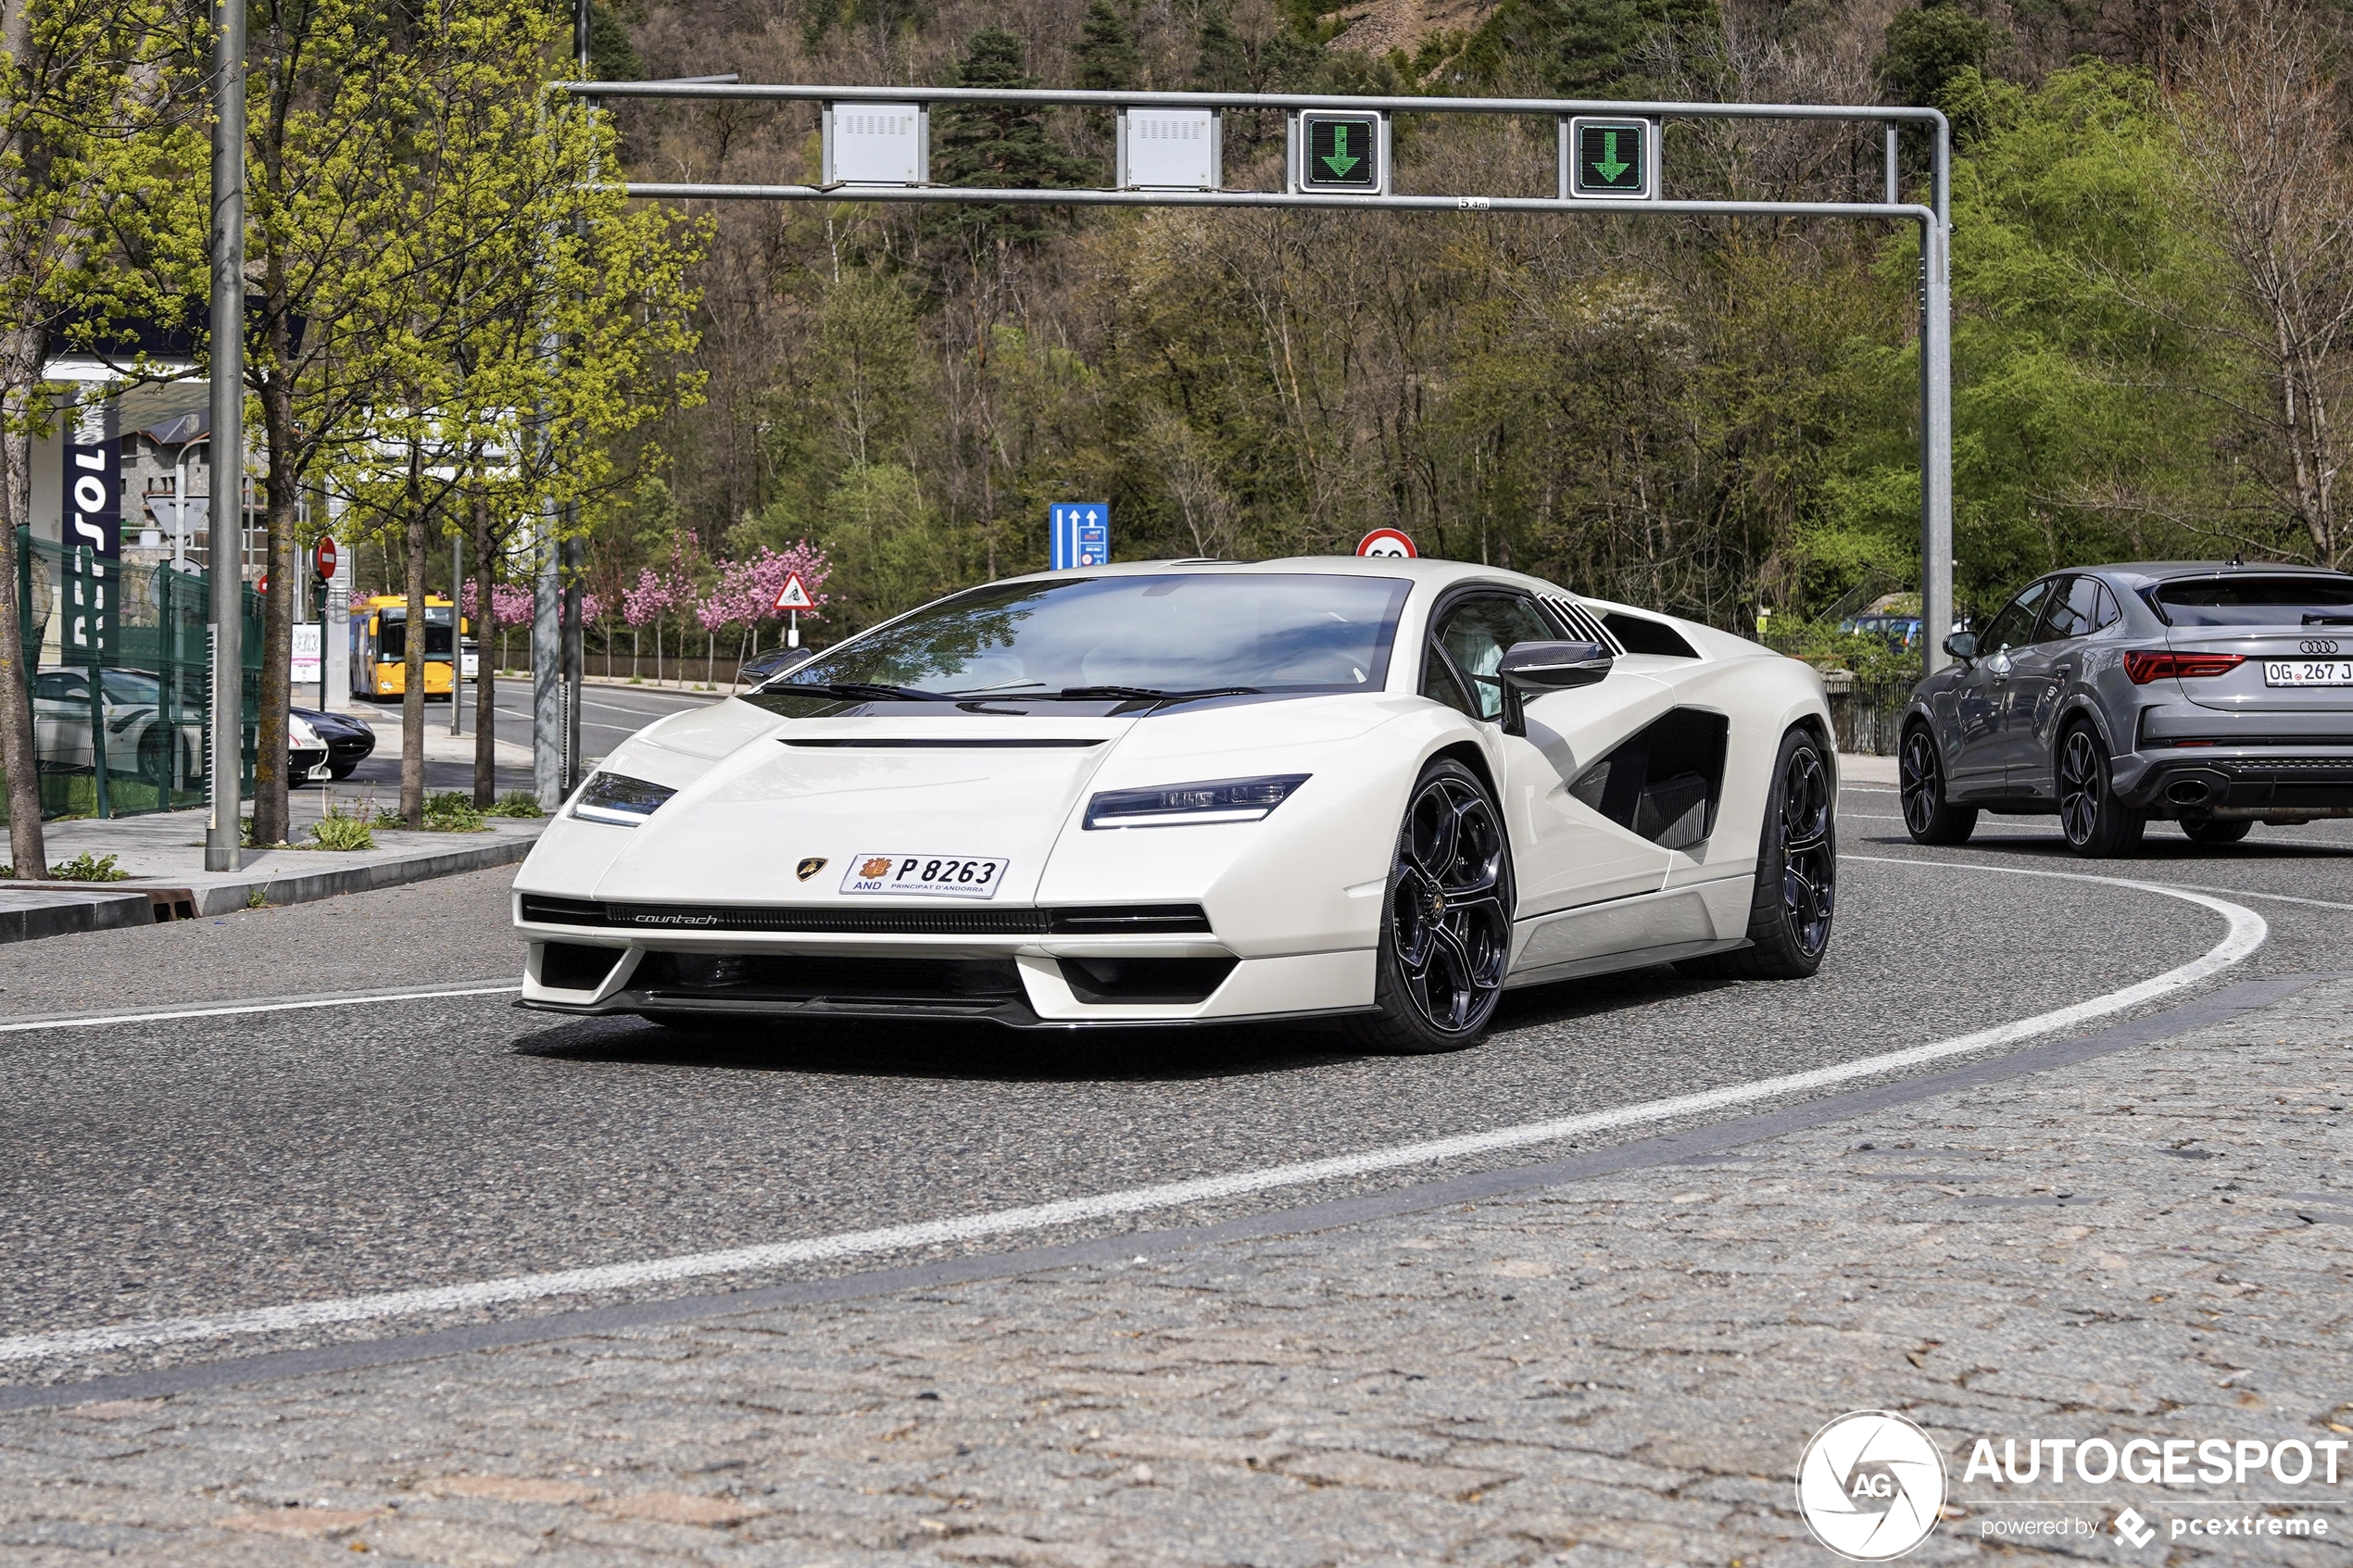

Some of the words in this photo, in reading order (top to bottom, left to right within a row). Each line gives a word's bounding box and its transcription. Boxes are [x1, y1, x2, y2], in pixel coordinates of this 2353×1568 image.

[1461, 198, 1488, 208] 5.4m
[2270, 664, 2293, 680] OG
[2304, 664, 2334, 680] 267
[896, 859, 918, 881] P
[921, 859, 996, 884] 8263
[853, 881, 882, 890] AND
[635, 914, 717, 924] countach
